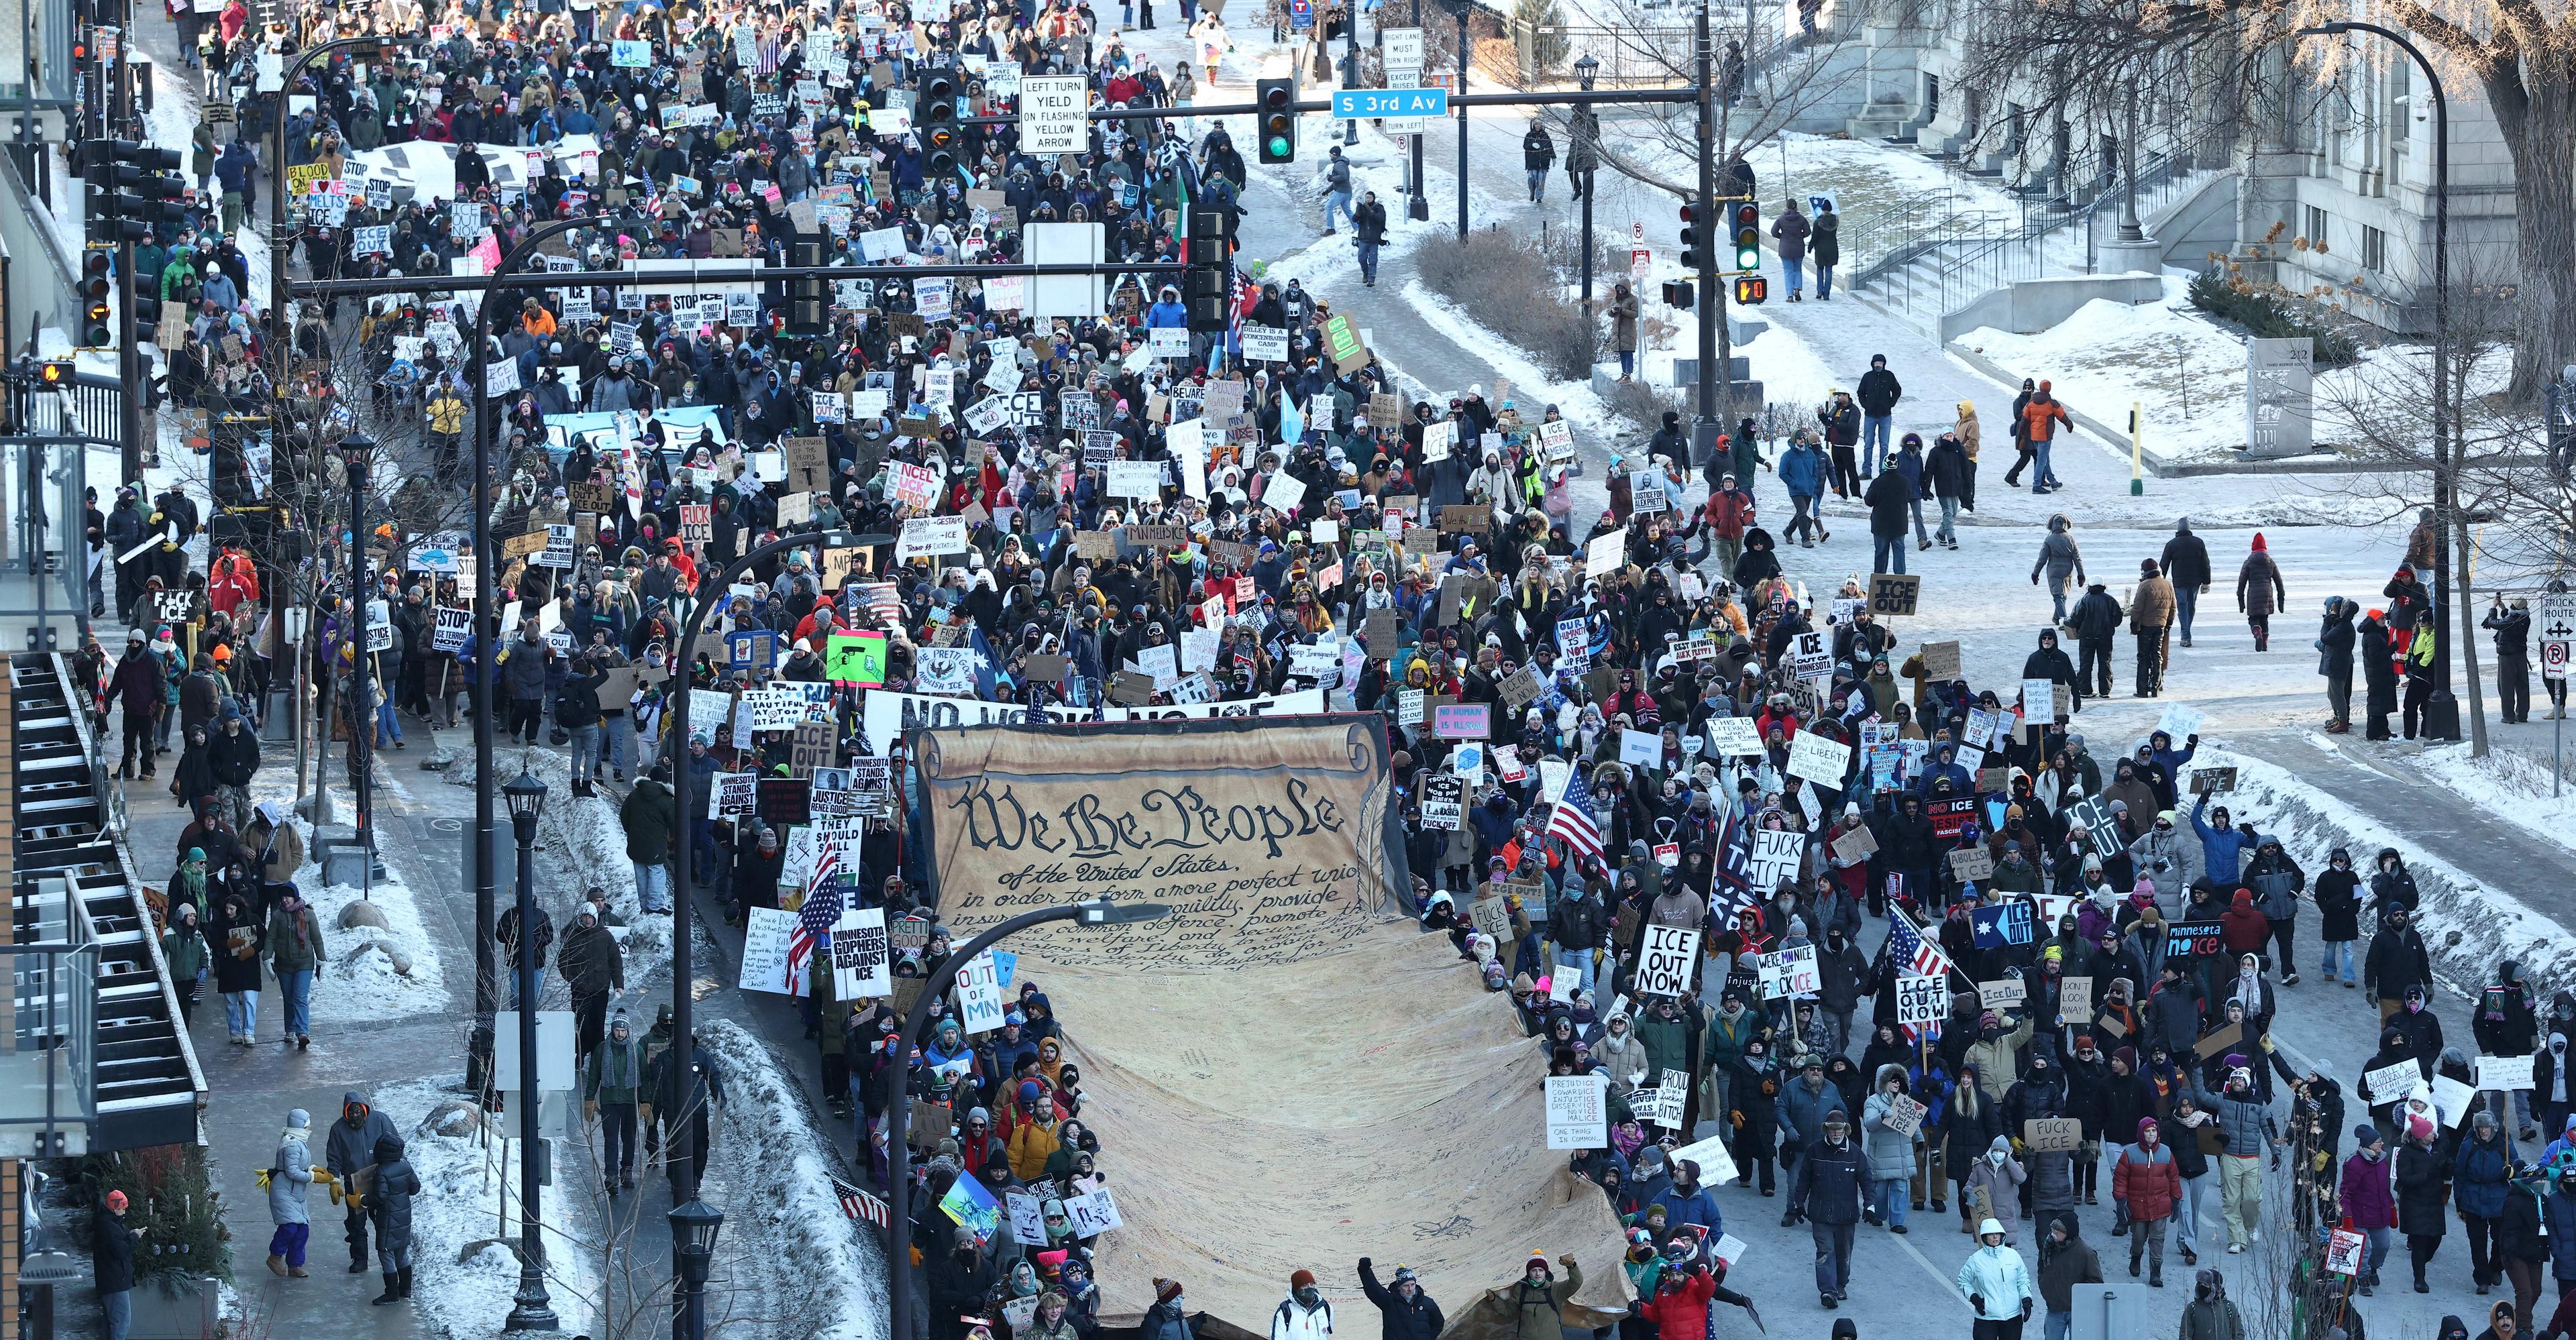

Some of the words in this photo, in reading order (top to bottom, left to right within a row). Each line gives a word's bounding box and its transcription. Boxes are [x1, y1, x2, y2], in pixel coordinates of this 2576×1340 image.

[807, 35, 830, 49] ICE
[806, 50, 830, 62] OUT
[1026, 82, 1050, 92] LEFT
[1055, 82, 1081, 91] TURN
[756, 99, 781, 107] ARMED
[1036, 97, 1071, 107] YIELD
[1343, 98, 1354, 111] S
[1366, 98, 1399, 111] 3rd
[1412, 98, 1436, 109] Av
[1042, 111, 1084, 121] FLASHING
[1035, 125, 1074, 134] YELLOW
[1037, 138, 1072, 148] ARROW
[309, 196, 343, 208] MELTS
[453, 204, 478, 215] ICE
[310, 209, 330, 226] ICE
[453, 215, 478, 225] OUT
[453, 225, 480, 236] NOW
[674, 295, 698, 309] STOP
[894, 324, 919, 333] NOW
[1244, 333, 1287, 341] CONCENTRATION
[2291, 350, 2307, 359] 212
[1547, 424, 1563, 433] ICE
[1543, 433, 1570, 445] BETRAYS
[1085, 449, 1113, 458] MURDER
[1547, 444, 1572, 455] AMERICA
[573, 483, 602, 492] TRUMP
[573, 492, 592, 500] OUT
[575, 500, 589, 508] ICE
[591, 502, 610, 510] OUT
[682, 506, 709, 524] FUCK
[684, 524, 709, 541] ICE
[1214, 553, 1245, 565] COMING
[1875, 581, 1916, 600] ICE
[1875, 599, 1913, 613] OUT
[438, 610, 468, 628] STOP
[1560, 620, 1582, 629] OUR
[1569, 637, 1578, 645] IS
[1801, 634, 1822, 655] ICE
[1566, 645, 1587, 657] NOT
[1576, 656, 1588, 664] FOR
[1564, 665, 1591, 677] DEBATE
[1797, 662, 1831, 673] MINNESOTA
[720, 777, 755, 786] MINNESOTA
[723, 785, 751, 794] STANDS
[720, 794, 754, 804] AGAINST
[720, 805, 753, 815] ICE
[1928, 803, 1947, 814] NO
[1951, 801, 1973, 810] ICE
[1059, 794, 1152, 858] the
[1142, 778, 1344, 859] People
[1756, 832, 1803, 857] FUCK
[998, 864, 1034, 890] of
[1030, 862, 1069, 884] the
[1071, 856, 1152, 882] United
[994, 887, 1057, 906] order
[1169, 882, 1216, 896] more
[1218, 864, 1301, 904] perfect
[1475, 903, 1506, 924] FUCK
[2007, 903, 2029, 924] ICE
[893, 921, 927, 934] PRETTI
[1482, 921, 1504, 934] ICE
[2008, 923, 2029, 943] OUT
[833, 927, 883, 942] MINNESOTA
[893, 935, 927, 946] GOOD
[1650, 928, 1692, 952] ICE
[836, 951, 886, 968] AGAINST
[1649, 953, 1687, 974] OUT
[856, 967, 873, 980] ICE
[958, 964, 994, 988] OUT
[1639, 970, 1683, 993] NOW
[2064, 982, 2089, 990] DON'T
[970, 989, 983, 999] OF
[2063, 993, 2086, 1002] LOOK
[967, 998, 999, 1021] MN
[2060, 1005, 2086, 1014] AWAY!
[1552, 1080, 1595, 1088] PREJUDICE
[1662, 1071, 1689, 1091] PROUD
[1658, 1104, 1682, 1122] BITCH
[2037, 1121, 2070, 1133] FUCK
[2039, 1137, 2070, 1150] ICE
